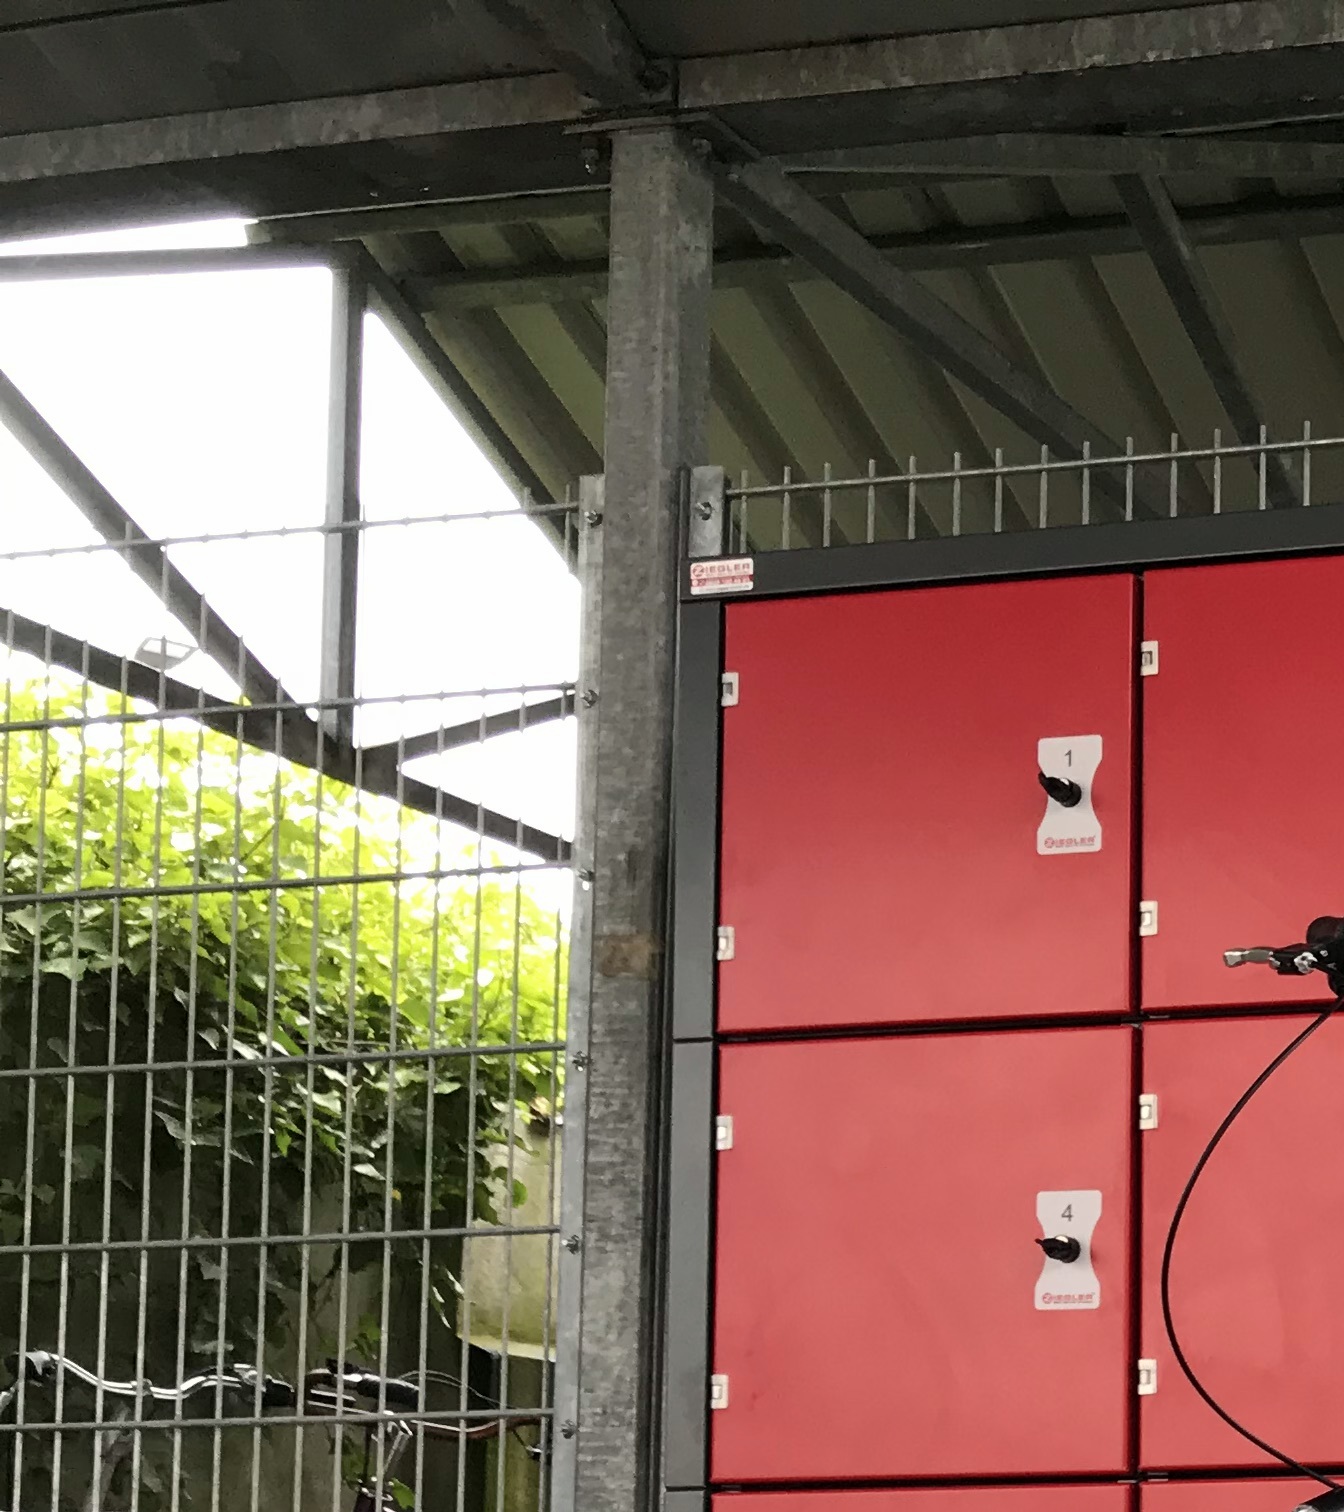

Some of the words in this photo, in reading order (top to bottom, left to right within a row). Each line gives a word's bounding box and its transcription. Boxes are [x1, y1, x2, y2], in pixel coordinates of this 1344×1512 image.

[692, 563, 750, 577] ZIEGLER
[1064, 749, 1073, 768] 1
[1061, 1204, 1074, 1222] 4
